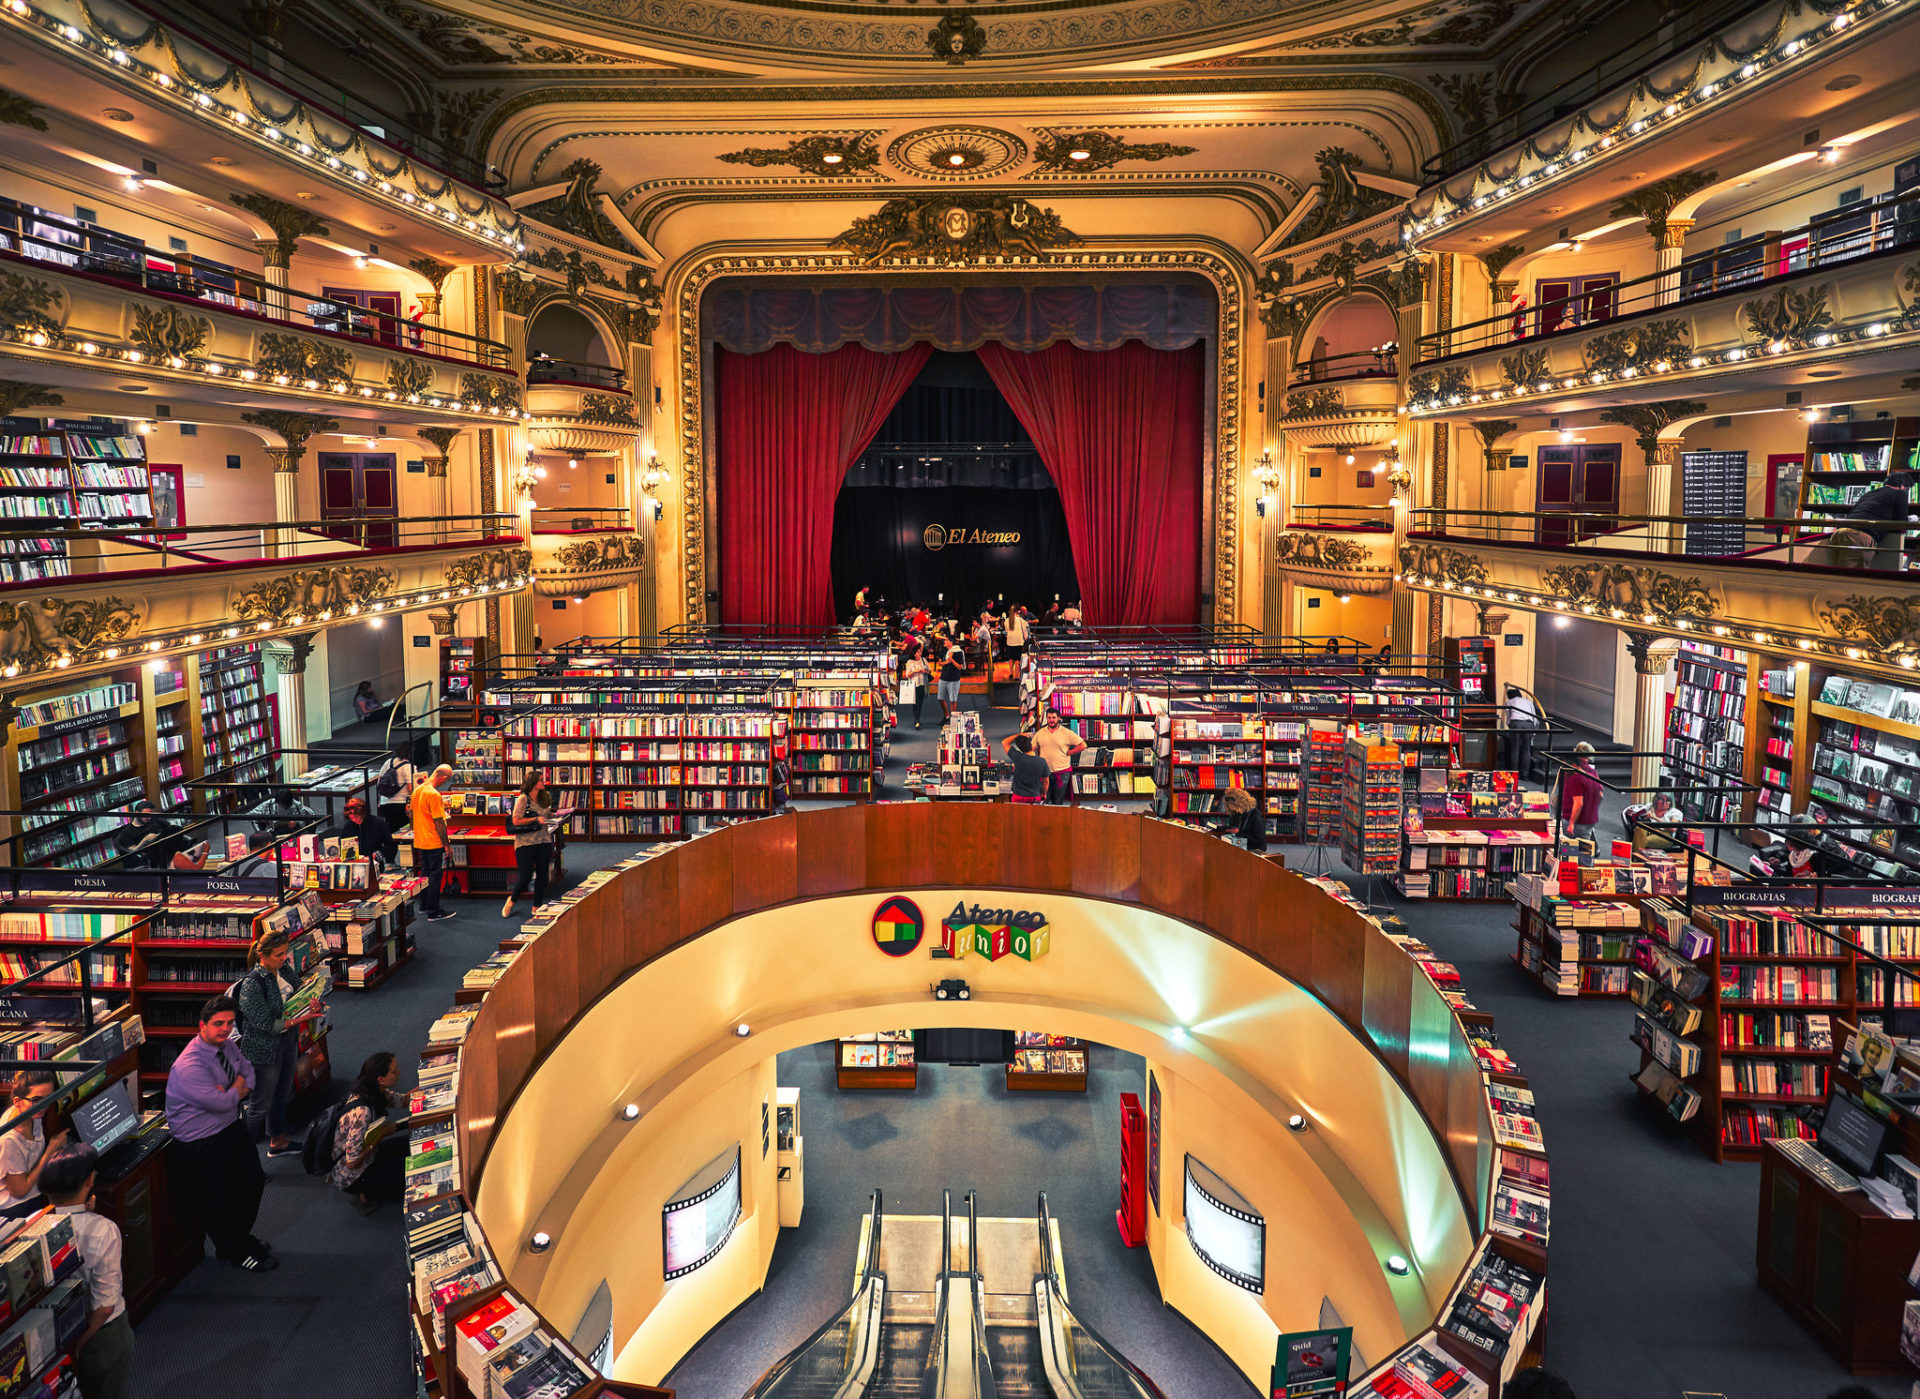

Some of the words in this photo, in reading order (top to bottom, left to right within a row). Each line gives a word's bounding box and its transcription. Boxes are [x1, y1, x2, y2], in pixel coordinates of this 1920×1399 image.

[948, 528, 966, 544] El
[968, 528, 1021, 544] Ateneo
[54, 720, 76, 731] NOVELA
[74, 878, 107, 887] POESIA
[207, 881, 240, 891] POESIA
[1723, 892, 1786, 902] BIOGRAFIAS
[942, 900, 1047, 926] Ateneo
[1292, 1340, 1312, 1352] quid
